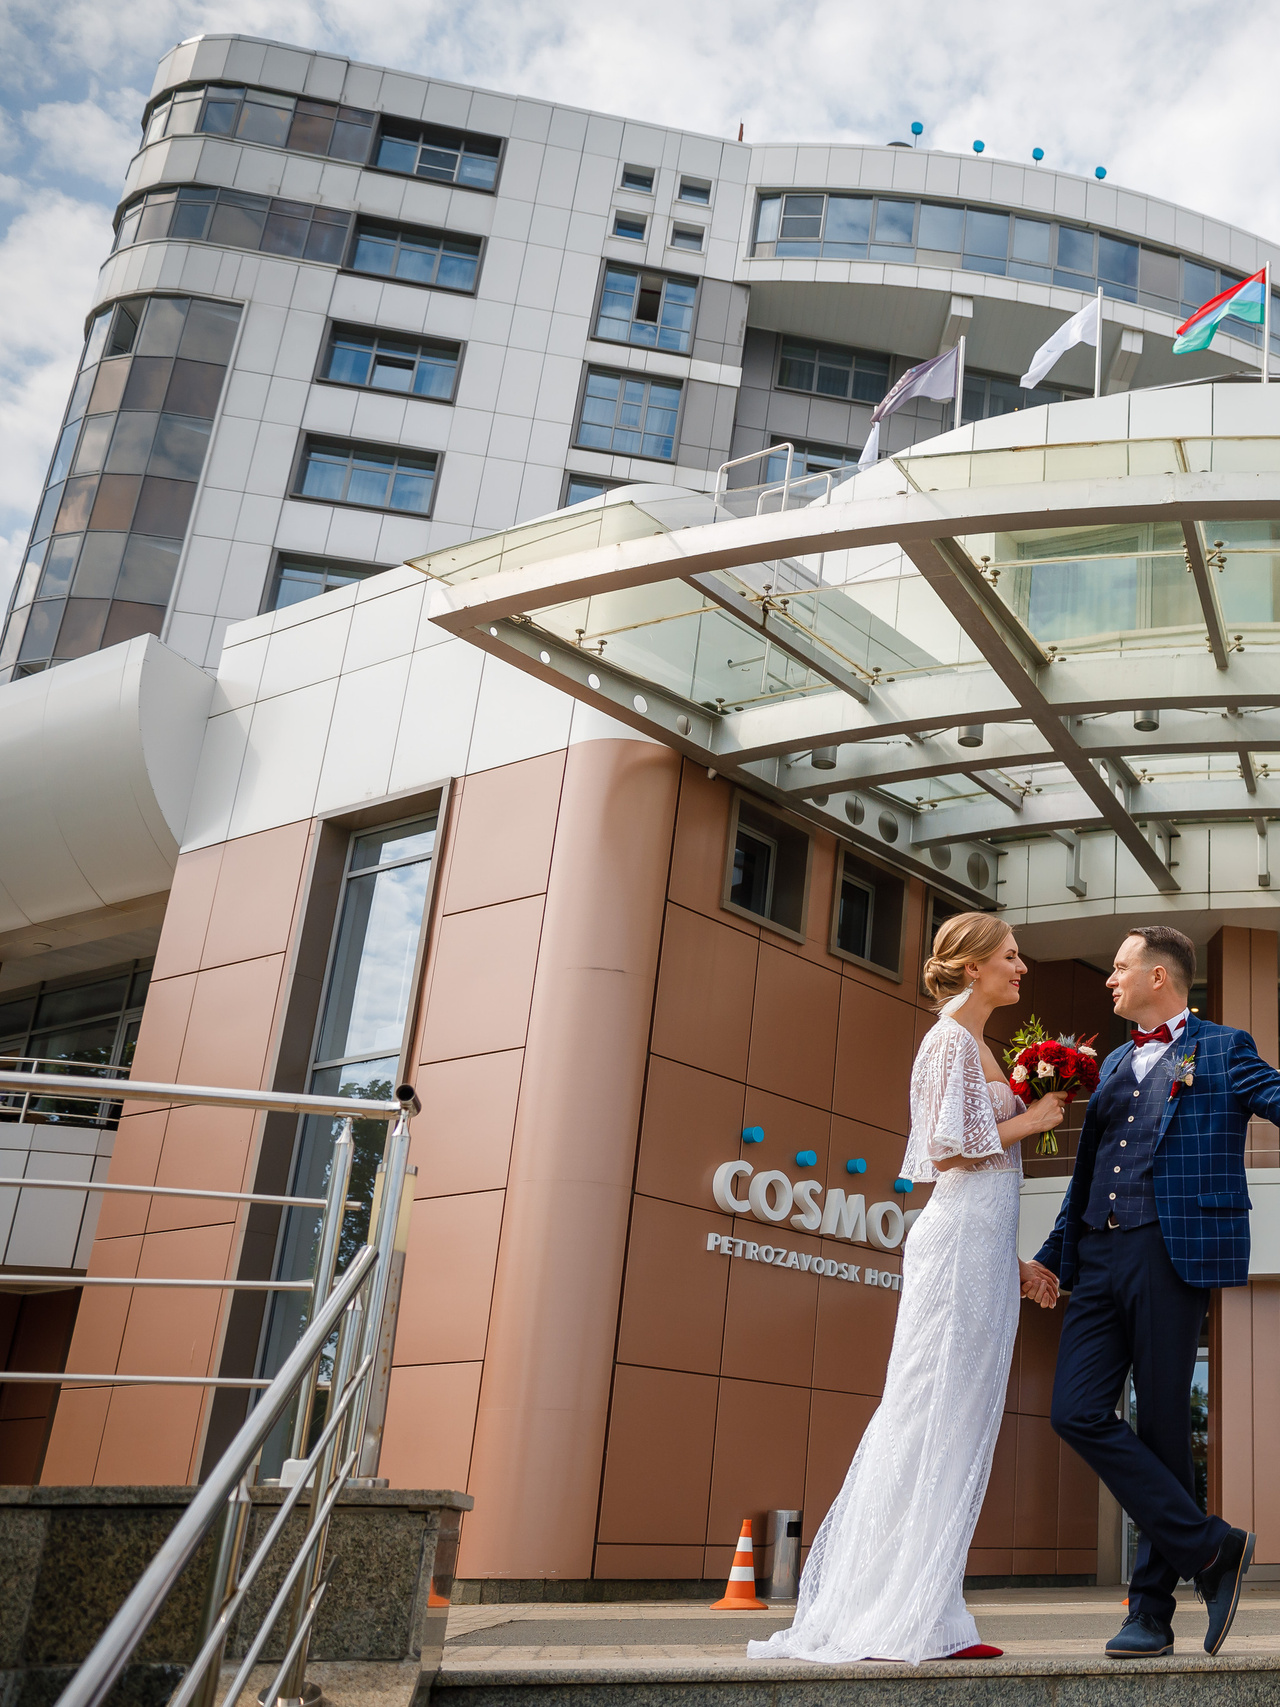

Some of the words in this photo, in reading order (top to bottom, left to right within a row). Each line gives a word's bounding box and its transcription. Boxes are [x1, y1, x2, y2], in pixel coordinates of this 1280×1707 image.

[712, 1159, 923, 1250] COSMO
[706, 1232, 861, 1283] PETROZAVODSK
[864, 1268, 903, 1292] HOT
